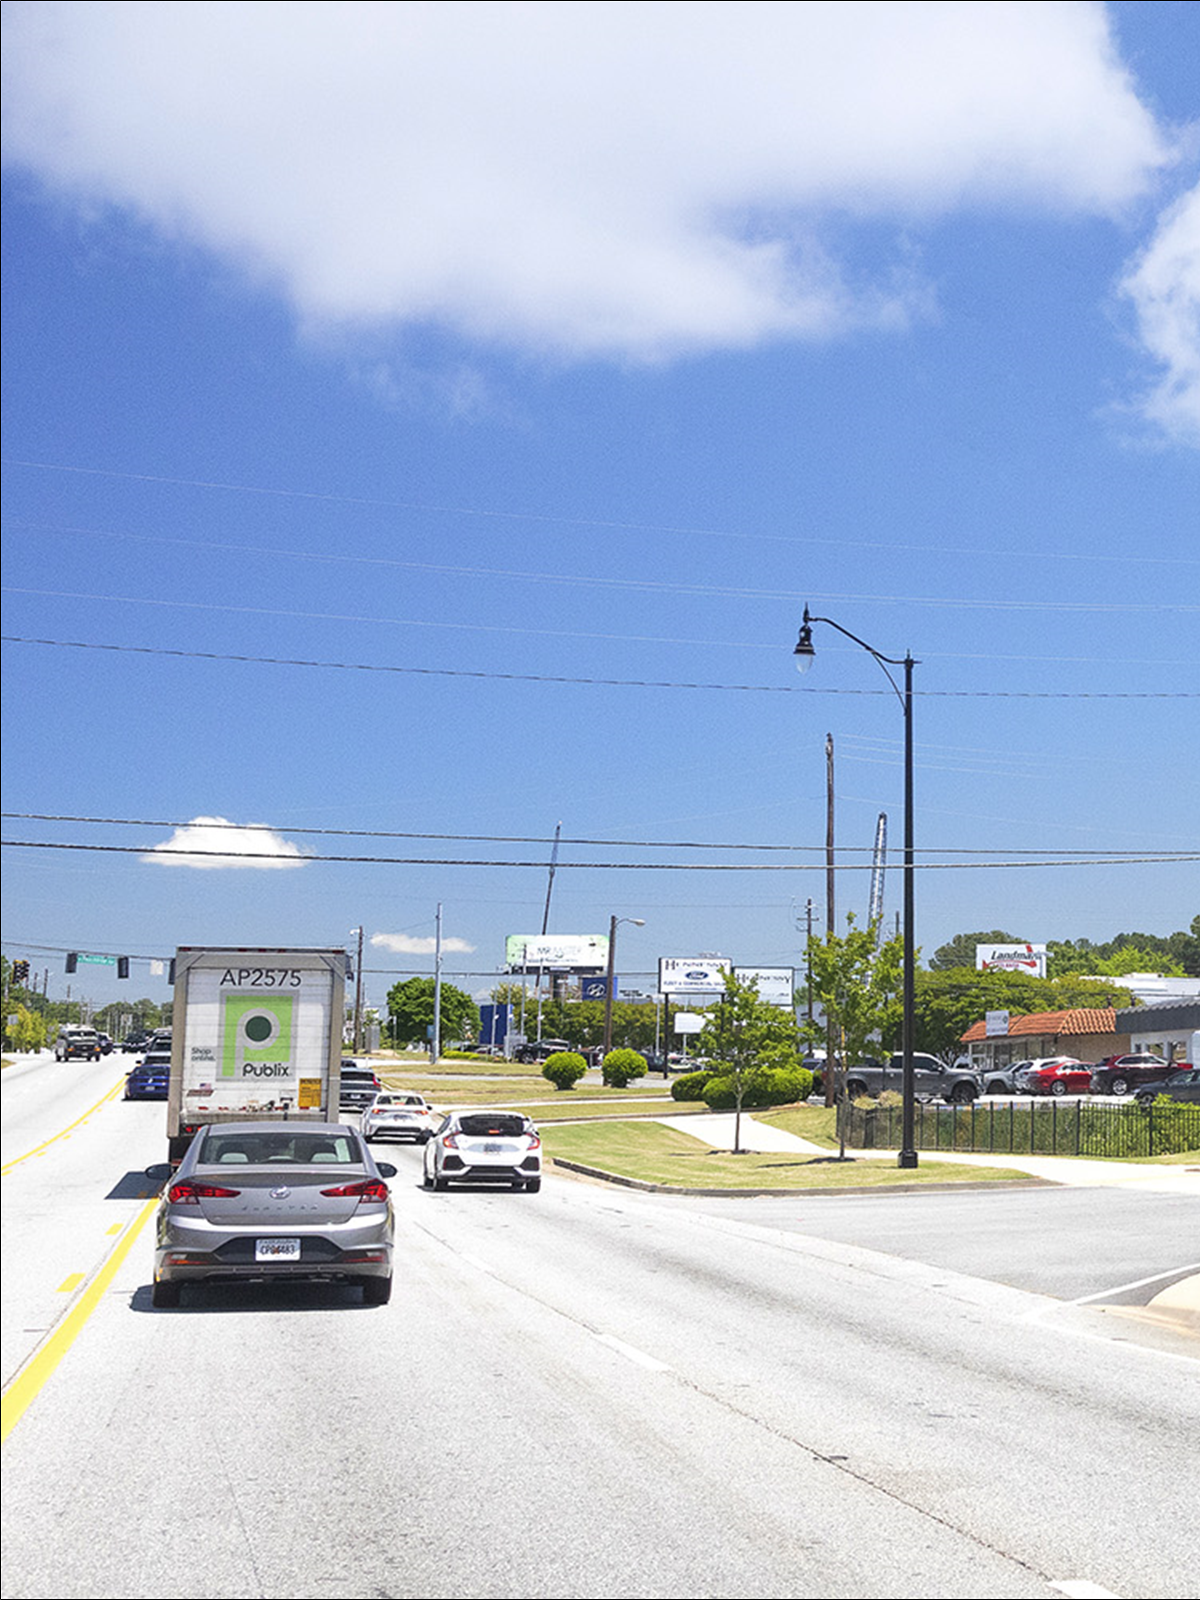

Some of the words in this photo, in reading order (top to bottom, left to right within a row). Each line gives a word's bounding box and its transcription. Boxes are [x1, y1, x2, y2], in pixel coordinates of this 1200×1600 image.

[220, 968, 301, 987] AP2575
[191, 1047, 212, 1055] Shop
[243, 1063, 289, 1077] Publix
